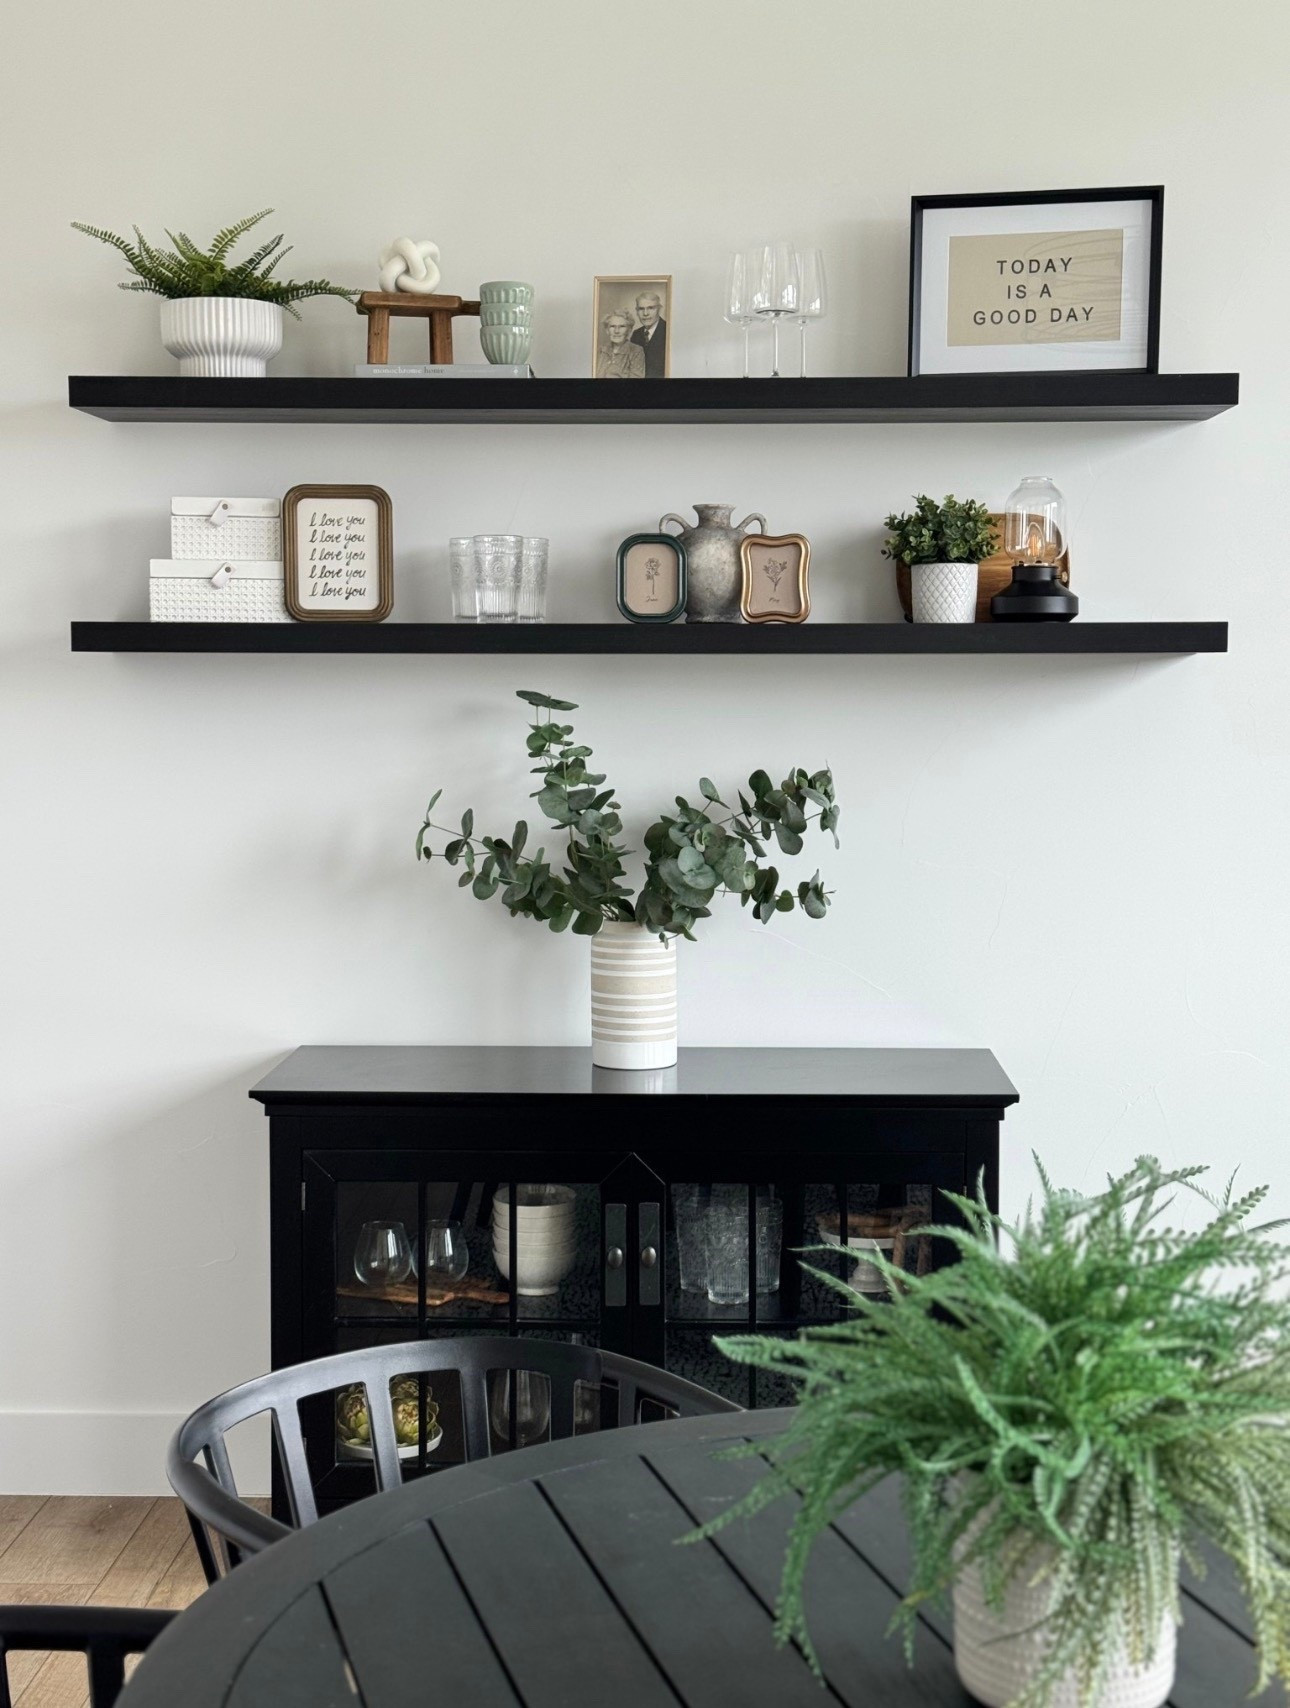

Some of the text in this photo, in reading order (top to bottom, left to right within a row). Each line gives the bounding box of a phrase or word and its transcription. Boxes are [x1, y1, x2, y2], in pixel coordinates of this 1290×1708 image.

[997, 257, 1073, 275] TODAY
[1007, 283, 1052, 299] IS A
[973, 306, 1094, 325] GOOD DAY
[373, 366, 445, 374] monochrome home
[319, 513, 343, 527] love
[346, 516, 366, 531] you
[319, 529, 341, 543] love
[344, 533, 366, 549] you
[318, 548, 343, 561] love
[345, 551, 366, 566] you
[318, 565, 343, 579] love
[345, 569, 367, 584] you
[321, 582, 343, 597] love
[345, 587, 367, 600] you
